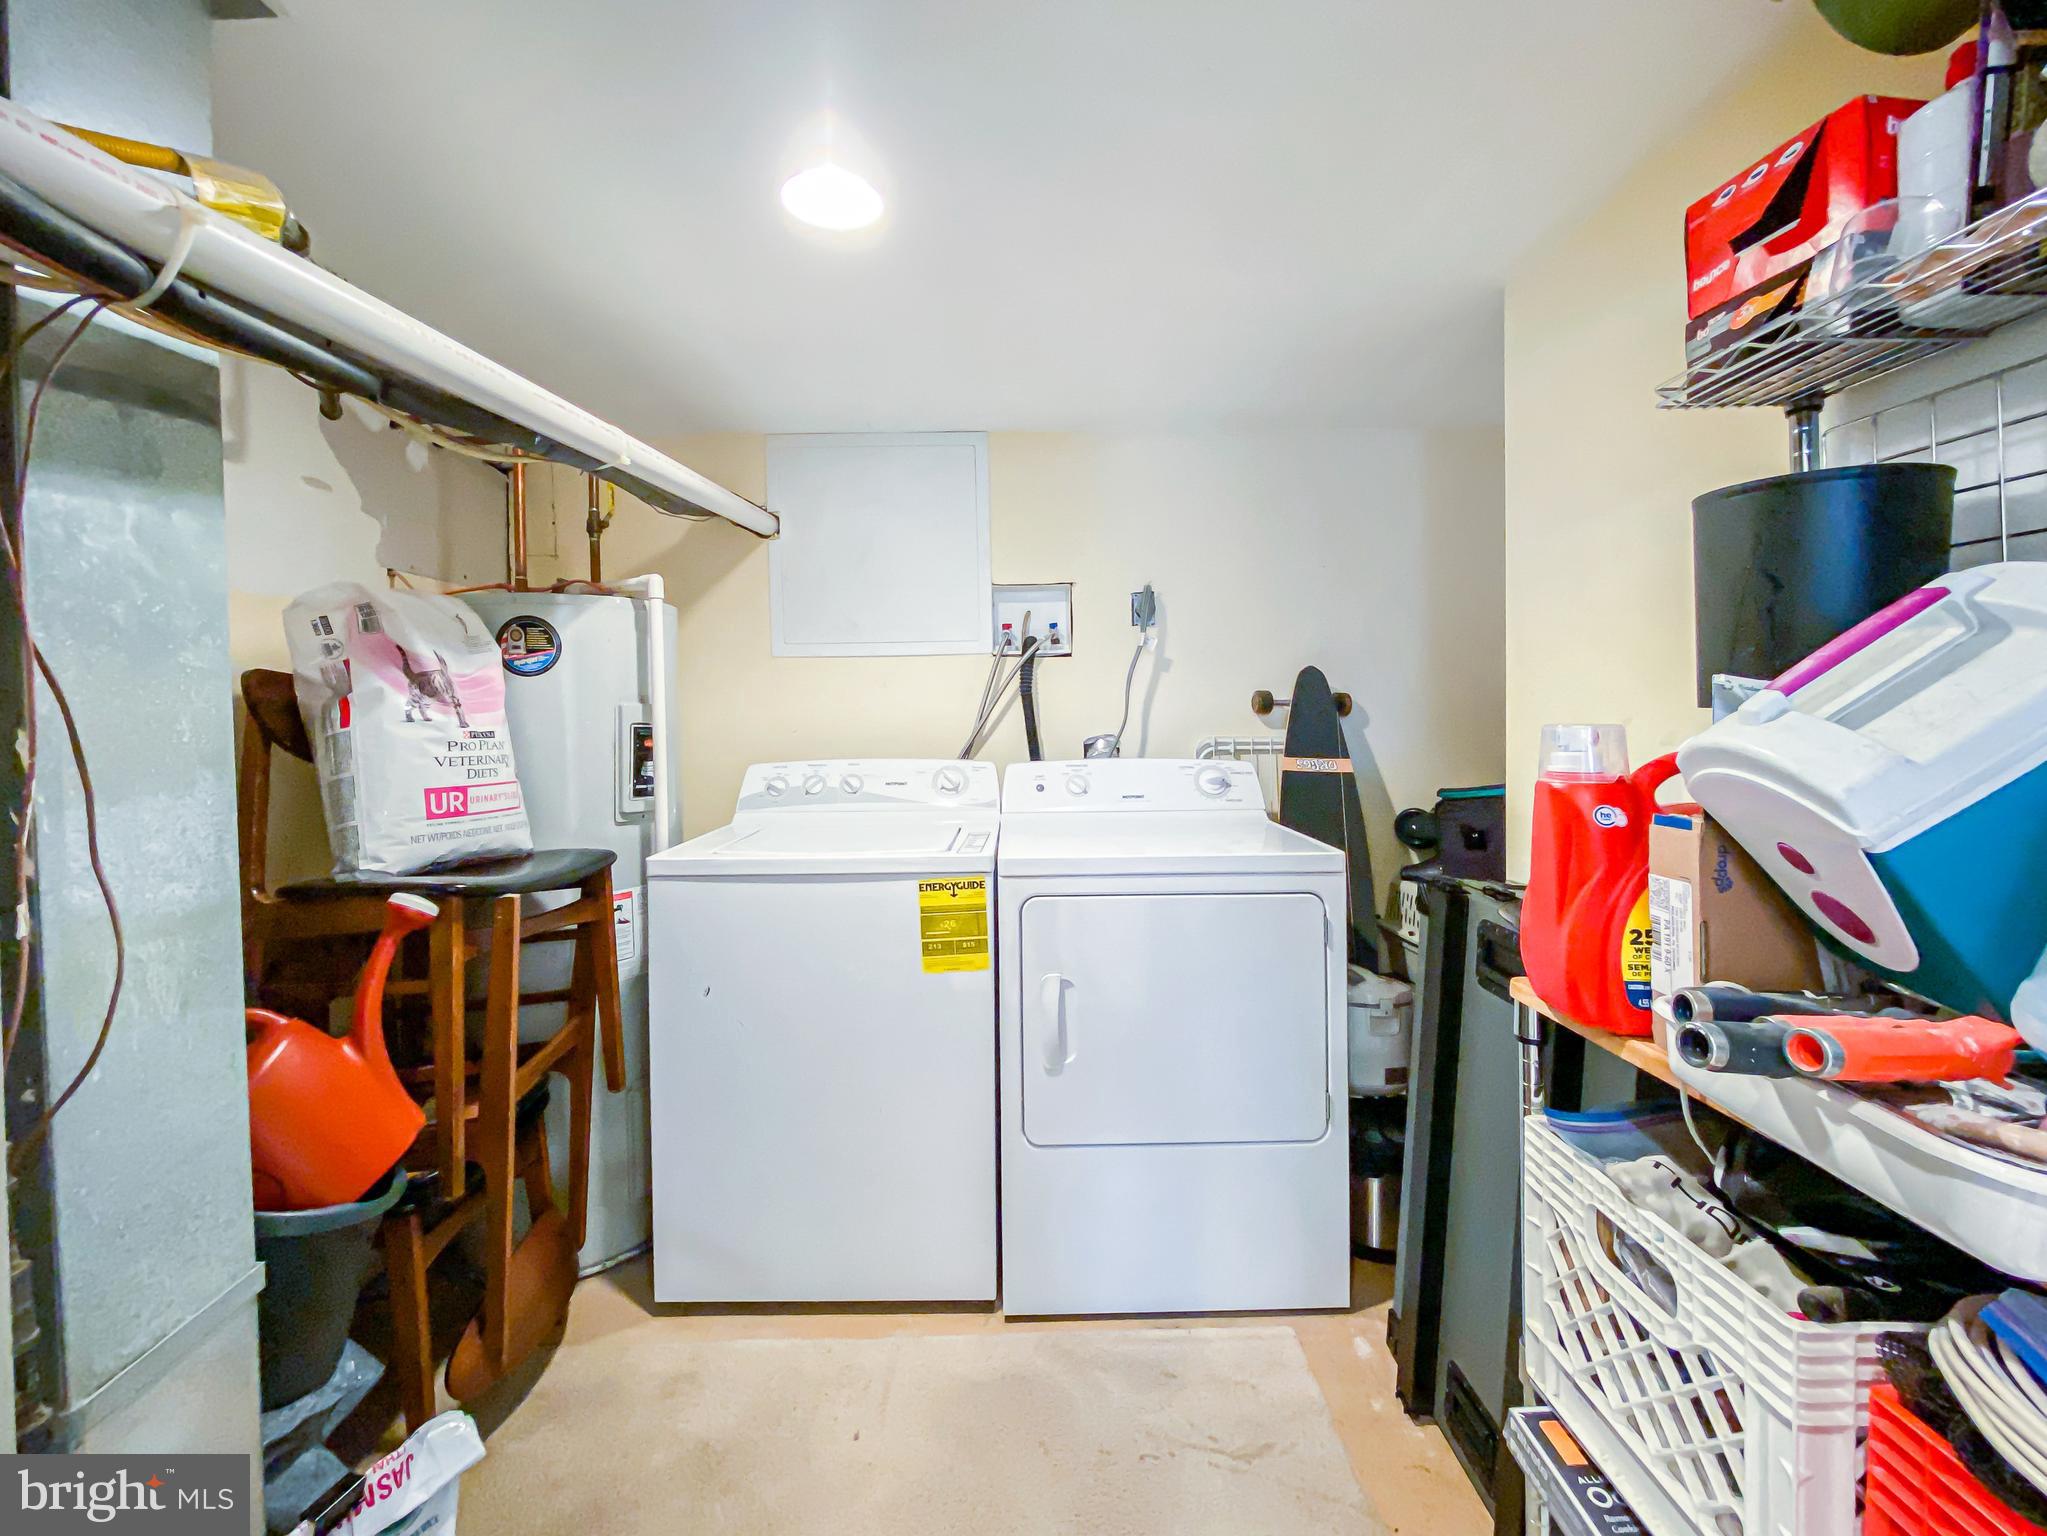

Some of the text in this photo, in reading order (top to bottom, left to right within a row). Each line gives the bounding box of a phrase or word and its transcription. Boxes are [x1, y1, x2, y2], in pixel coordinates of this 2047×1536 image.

[447, 740, 476, 752] PRO
[434, 754, 509, 767] VETERINARY
[467, 768, 499, 779] DIETS
[430, 791, 464, 814] UR
[1600, 809, 1611, 819] he
[919, 881, 986, 894] ENERGYGUIDE
